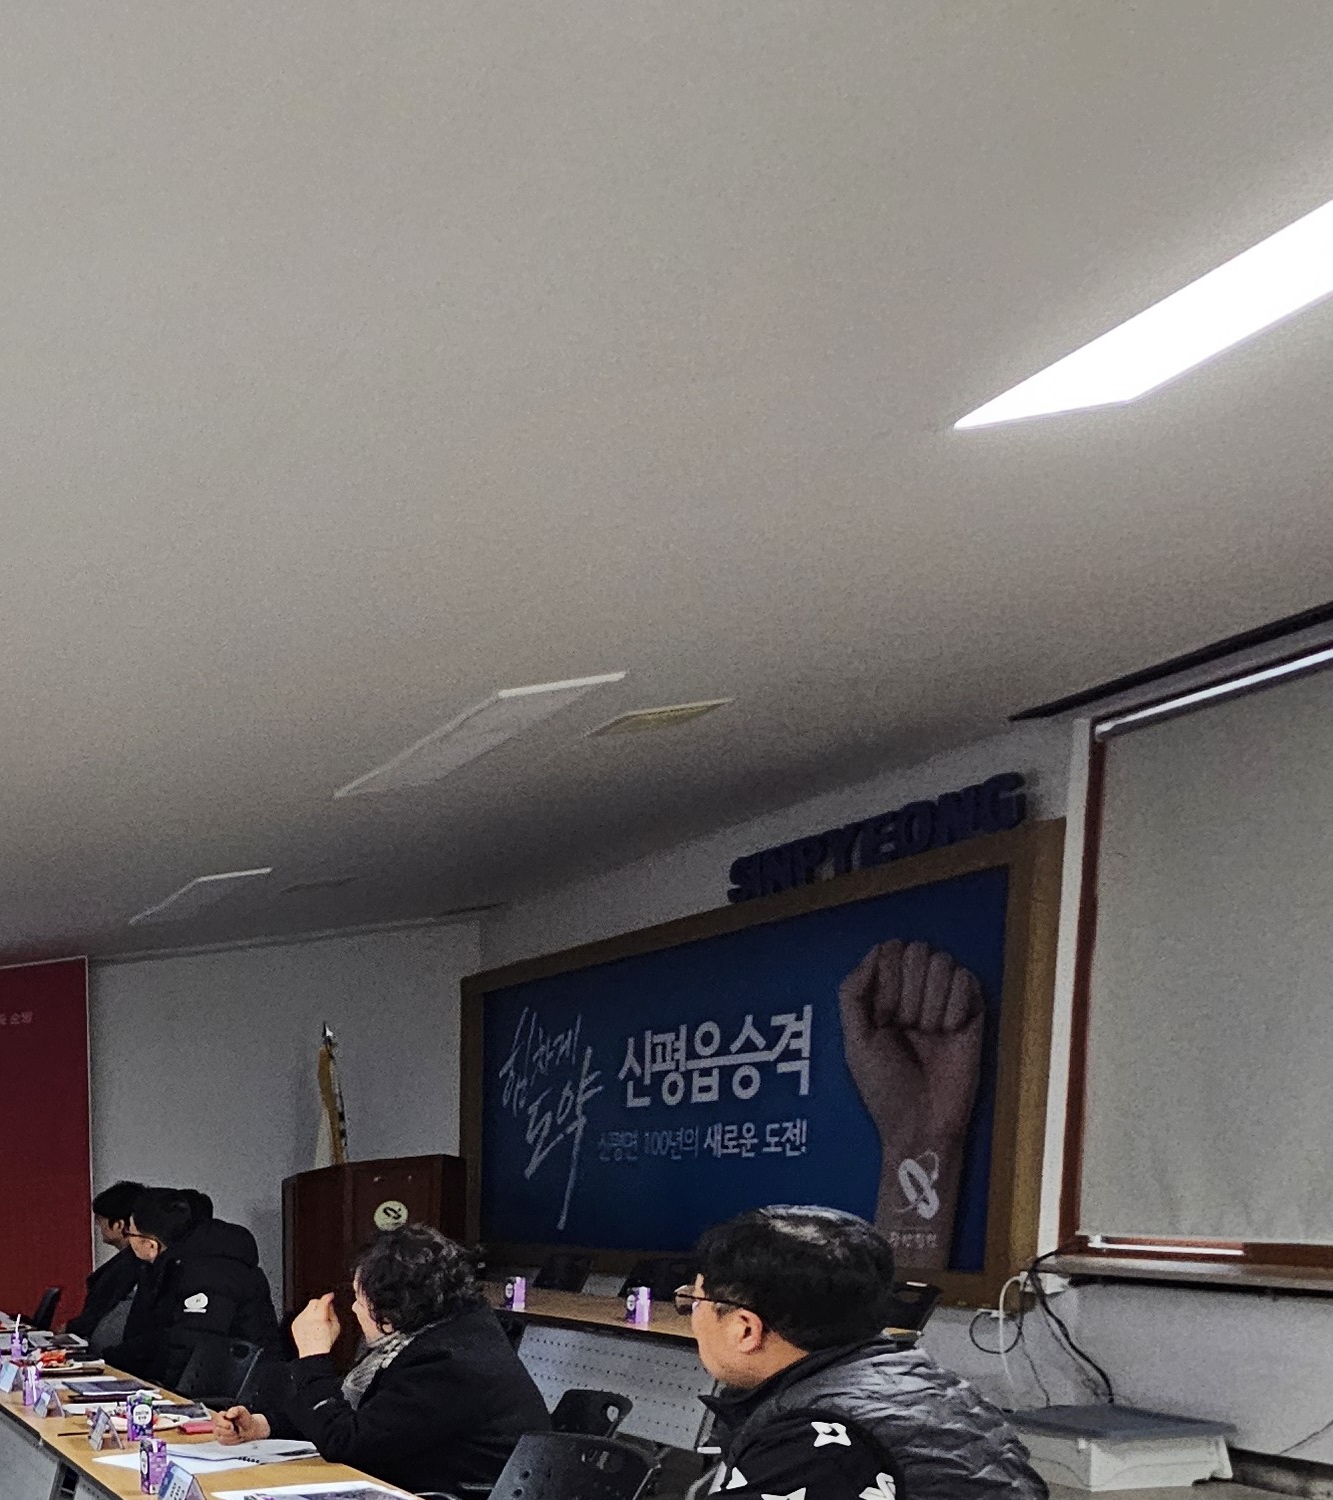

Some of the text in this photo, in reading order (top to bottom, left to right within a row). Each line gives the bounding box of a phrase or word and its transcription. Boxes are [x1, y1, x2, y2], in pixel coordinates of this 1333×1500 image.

[727, 772, 1027, 904] SINPYEONG
[617, 1004, 813, 1108] 신평읍승격
[703, 1122, 759, 1158] 새로운
[762, 1117, 809, 1157] 도전!
